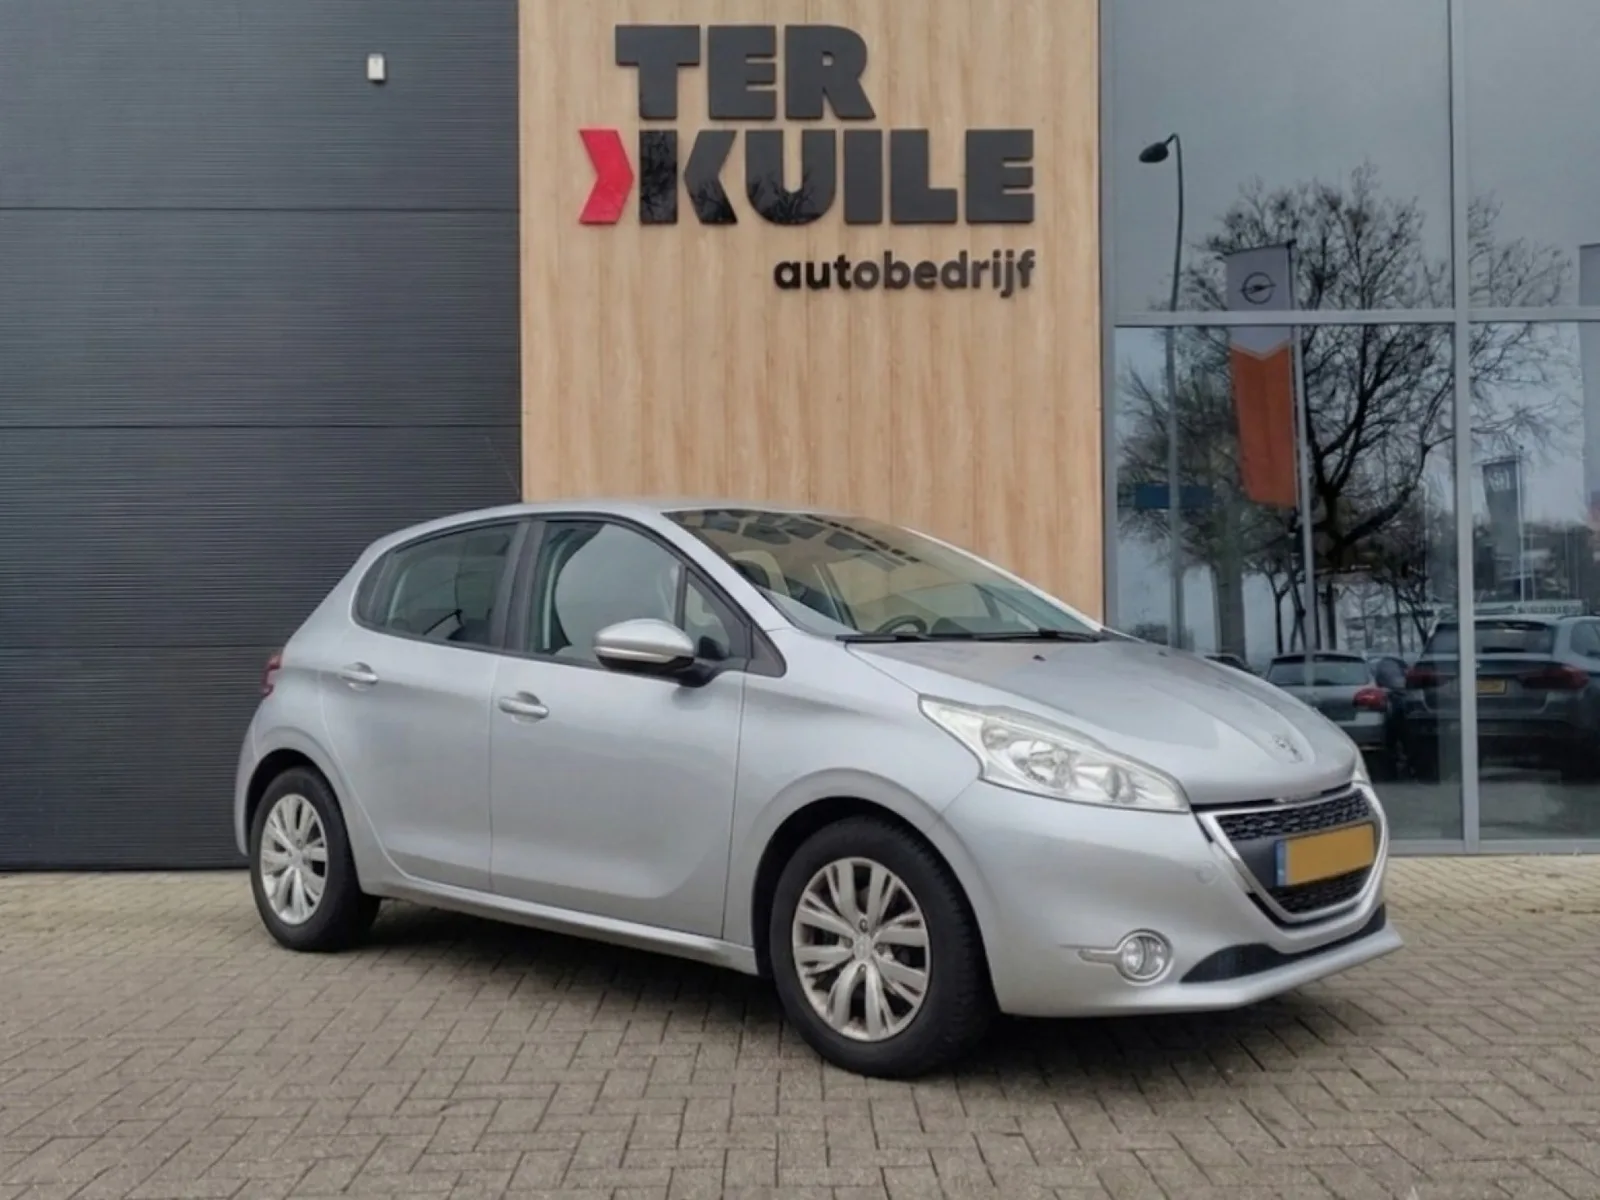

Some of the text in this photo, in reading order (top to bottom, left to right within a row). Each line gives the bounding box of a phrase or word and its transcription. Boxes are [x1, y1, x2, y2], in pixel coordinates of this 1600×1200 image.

[615, 25, 876, 120] TER
[638, 129, 1035, 225] KUILE
[774, 249, 1036, 298] autobedrijf
